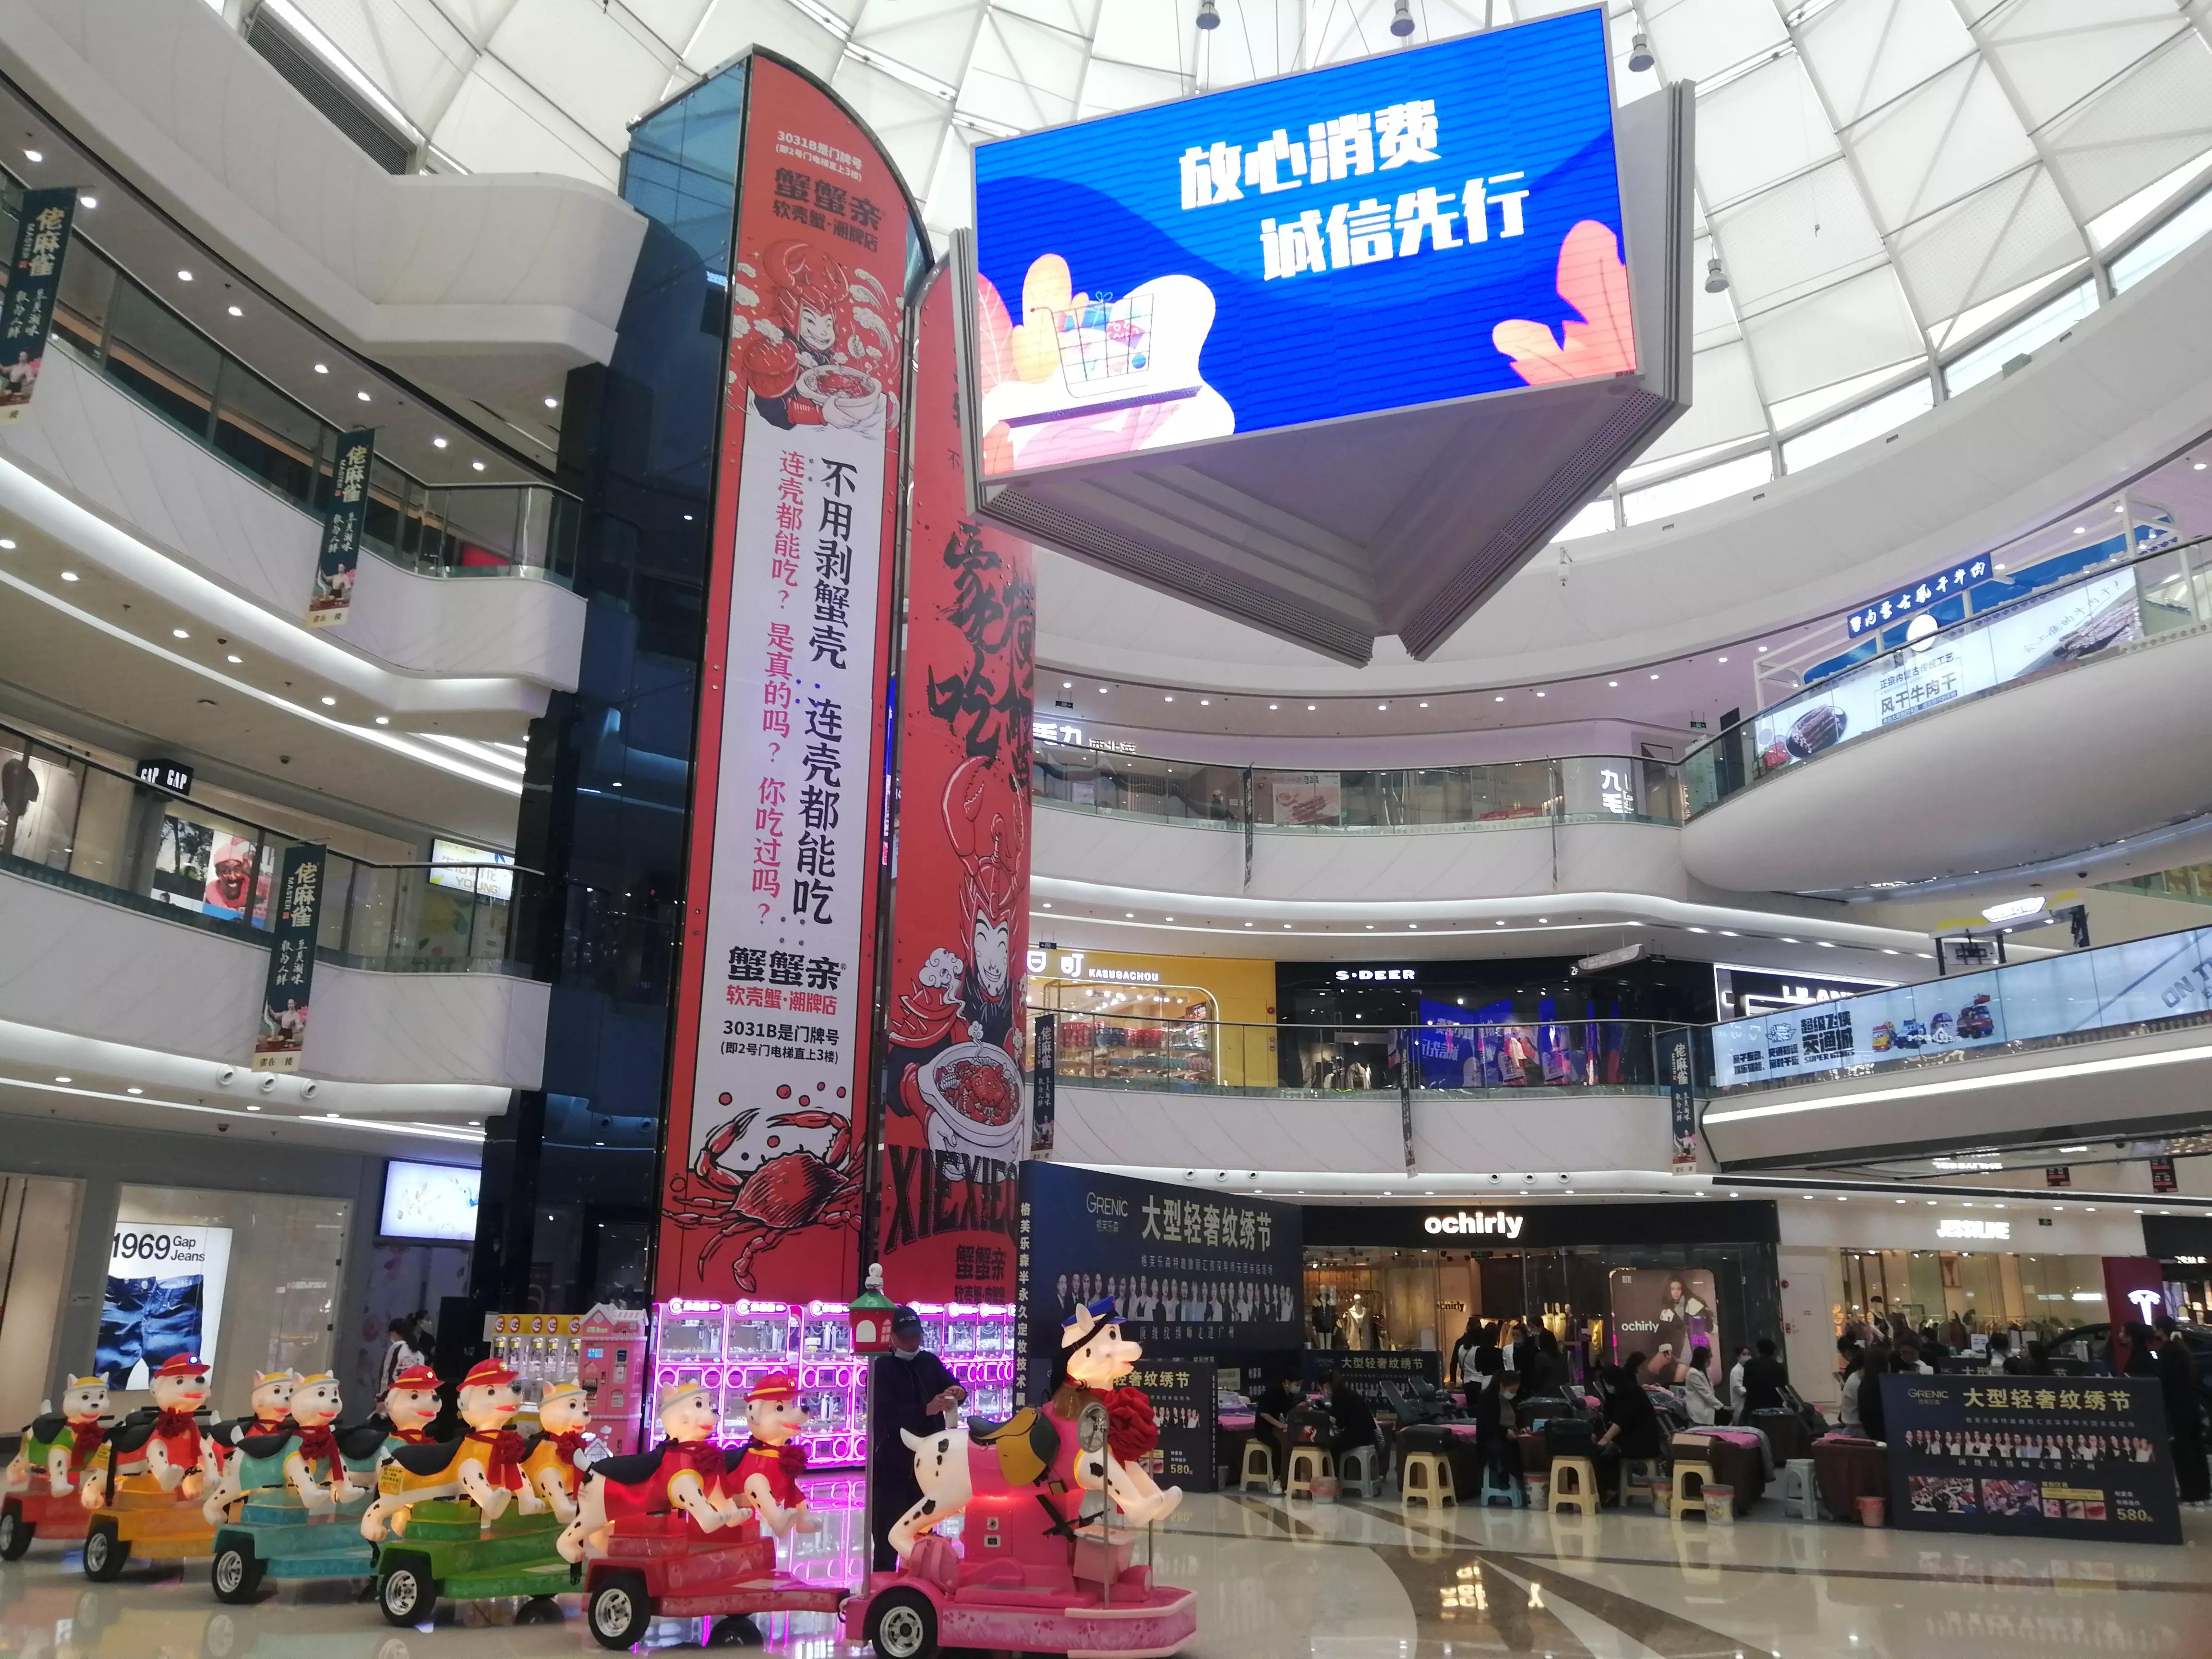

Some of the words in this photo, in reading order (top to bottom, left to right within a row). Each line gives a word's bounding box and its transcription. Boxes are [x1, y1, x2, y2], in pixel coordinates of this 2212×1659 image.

[777, 131, 863, 170] 3031B是门牌号
[1178, 99, 1442, 210] 放心消费
[774, 167, 882, 230] 蟹蟹亲
[1260, 171, 1529, 281] 诚信先行
[808, 457, 858, 670] 不用剥蟹壳
[1881, 672, 1957, 716] 风干牛肉干
[141, 768, 159, 784] GAP
[167, 769, 188, 790] GAP
[793, 695, 843, 926] 连壳都能吃
[284, 877, 294, 910] MASTER
[290, 862, 318, 927] 佬麻雀
[728, 946, 842, 991] 蟹蟹亲
[1089, 968, 1159, 982] KASUGACHOU
[726, 984, 837, 1016] 软壳蟹·潮牌店
[2161, 975, 2196, 1008] ON
[723, 1020, 840, 1046] 3031B是门牌号
[1800, 1010, 1852, 1034] 超级飞侠
[721, 1041, 839, 1065] (即2号门电梯直上3楼)
[1040, 1026, 1051, 1070] 佬麻雀
[1802, 1027, 1854, 1056] 交通城
[1804, 1054, 1829, 1063] SUPER
[1142, 1194, 1272, 1252] 大型轻奢纹绣节
[1424, 1211, 1524, 1239] ochirly
[113, 1233, 170, 1260] 1969
[173, 1235, 196, 1250] Gap
[170, 1250, 205, 1262] Jeans
[1622, 1321, 1659, 1333] ochirly
[1341, 1357, 1424, 1370] 大型轻奢纹绣节
[1963, 1387, 2131, 1412] 大型轻奢纹绣节
